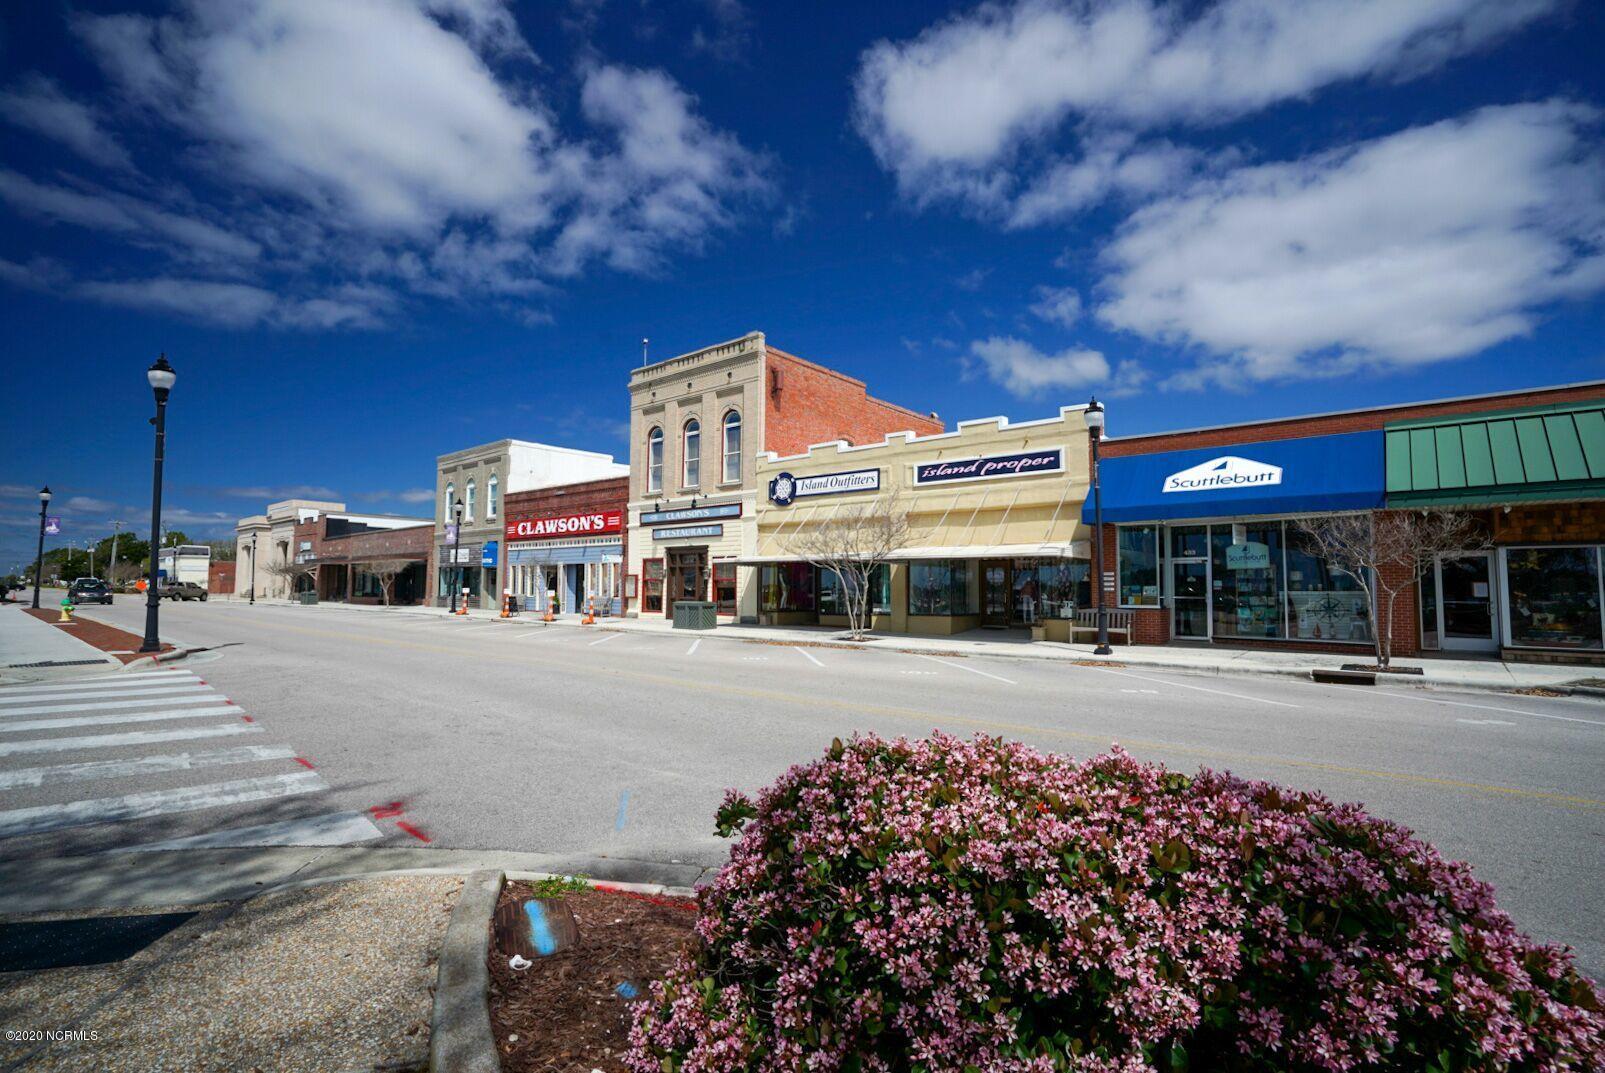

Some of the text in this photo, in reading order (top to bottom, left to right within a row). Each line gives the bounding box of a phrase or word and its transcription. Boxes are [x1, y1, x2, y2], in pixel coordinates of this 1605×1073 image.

[921, 456, 1056, 478] island proper
[800, 474, 876, 493] Island Outfitters
[1168, 472, 1275, 489] Scuttlebutt
[665, 508, 711, 521] CLAWSON'S
[517, 514, 605, 536] CLAWSON'S
[660, 527, 714, 538] RESTAURANT
[1228, 552, 1267, 563] Scuttlebutt
